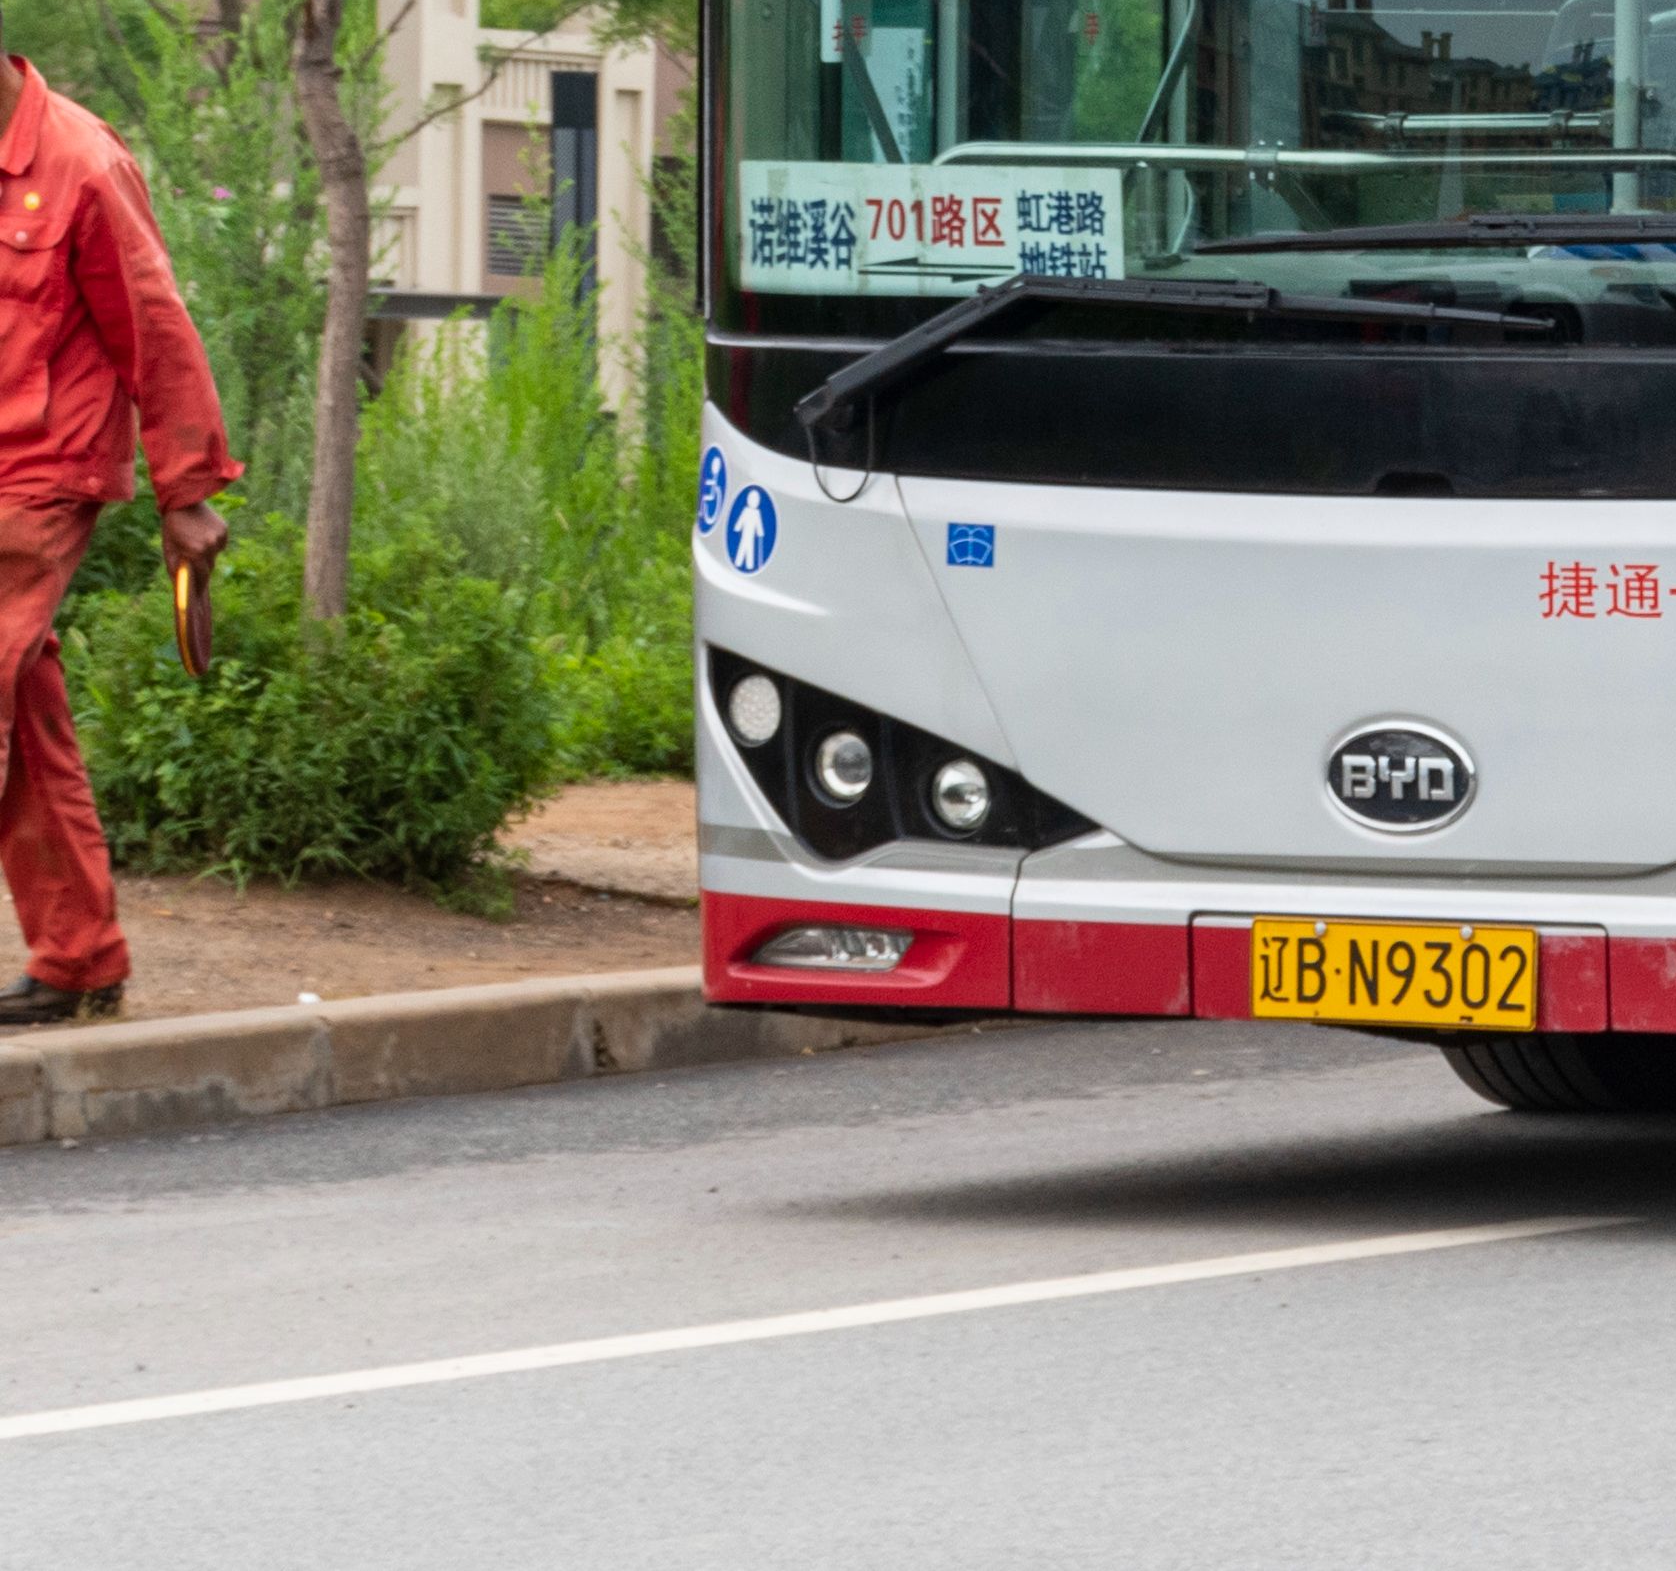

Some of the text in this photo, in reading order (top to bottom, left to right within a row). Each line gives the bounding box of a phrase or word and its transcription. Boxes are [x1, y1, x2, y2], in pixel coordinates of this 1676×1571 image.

[749, 197, 856, 270] 诺维溪谷
[866, 194, 1005, 248] 701路区
[1017, 189, 1105, 236] 虹港路
[1342, 755, 1455, 801] BYD
